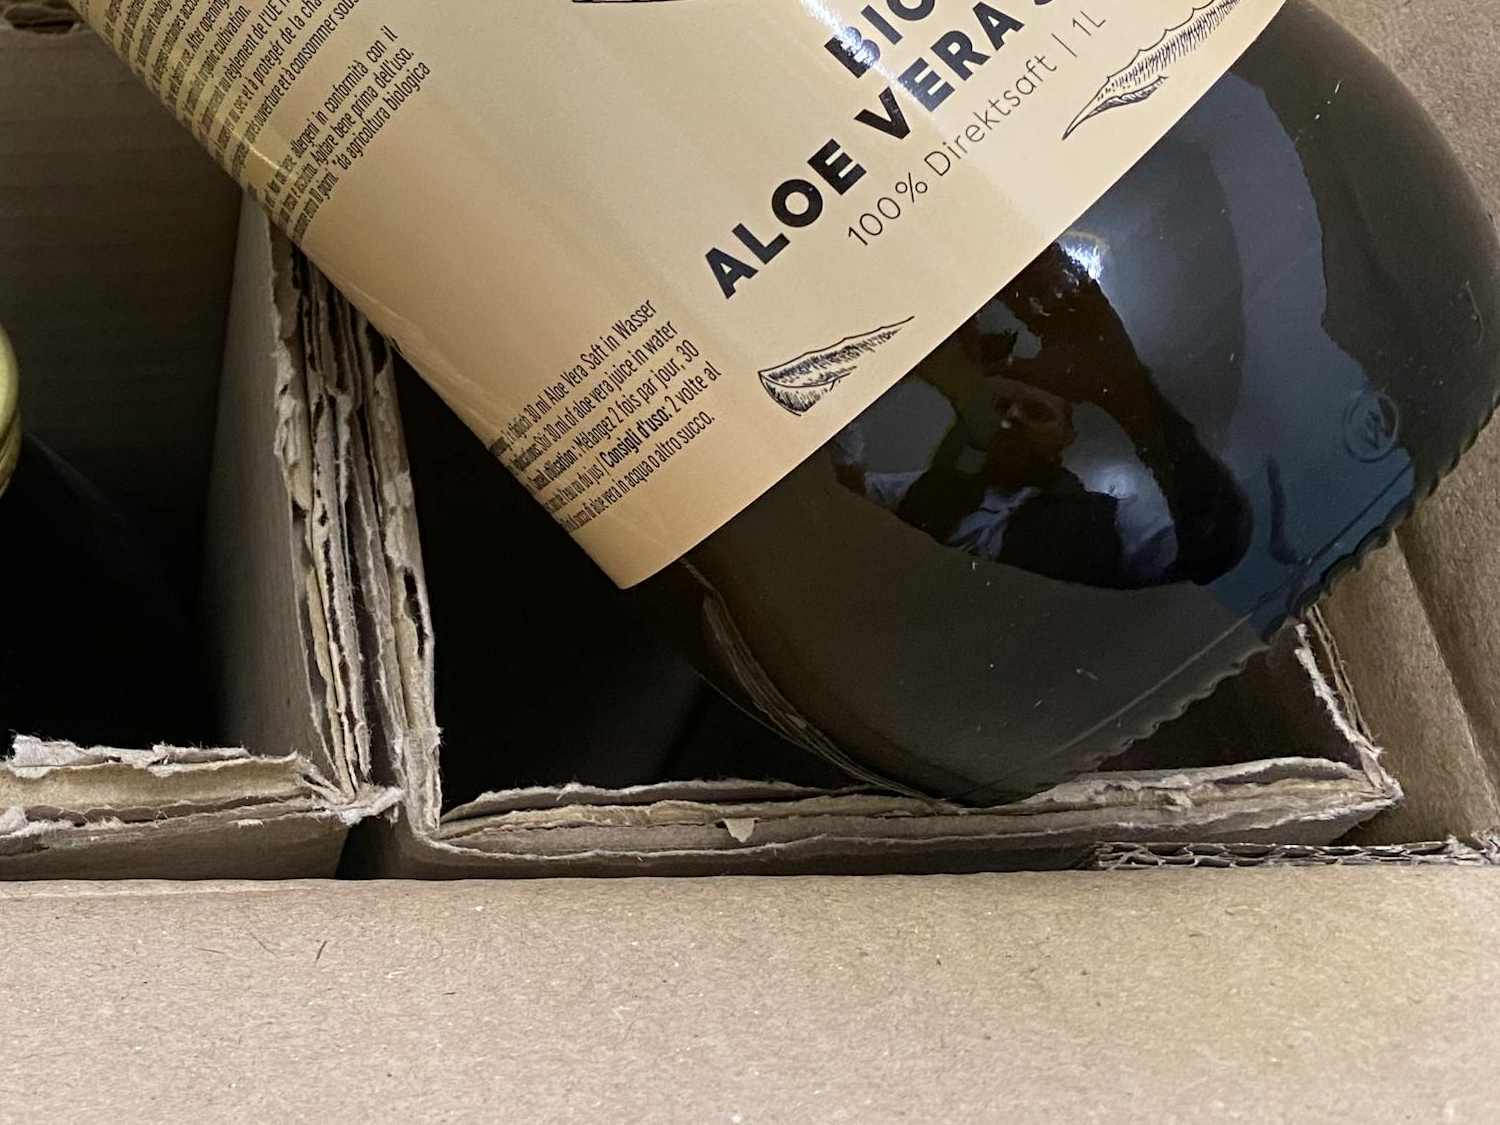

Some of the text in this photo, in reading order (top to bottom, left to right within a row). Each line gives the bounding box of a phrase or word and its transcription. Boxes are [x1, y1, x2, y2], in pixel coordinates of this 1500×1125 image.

[213, 5, 252, 55] cultivation.
[287, 14, 306, 31] la
[184, 26, 206, 54] After
[278, 26, 297, 45] de
[289, 13, 339, 75] consommer
[222, 33, 260, 83] règlement
[250, 22, 268, 41] de
[252, 39, 286, 87] protegér
[244, 76, 259, 91] à
[277, 73, 292, 91] et
[280, 66, 297, 82] à
[241, 83, 255, 101] et
[290, 117, 321, 159] allergeni
[311, 110, 329, 126] in
[323, 59, 370, 114] conformità
[365, 39, 388, 64] con
[380, 25, 398, 43] il
[253, 84, 285, 127] ouverture
[309, 133, 339, 170] Agitare
[329, 112, 357, 139] bene
[350, 85, 379, 121] prima
[372, 47, 415, 89] dell'uso.
[345, 106, 391, 160] agricoltura
[381, 62, 431, 111] biologica
[847, 172, 929, 246] 100%
[924, 53, 1058, 177] Direktsaft
[1072, 9, 1107, 36] 1L
[705, 138, 867, 299] ALOE
[854, 1, 1025, 141] VERA
[611, 300, 657, 340] Wasser
[598, 335, 621, 352] in
[641, 321, 678, 355] water
[580, 343, 610, 370] Saft
[627, 348, 650, 367] in
[675, 339, 700, 363] 30
[559, 364, 589, 388] Vera
[603, 358, 638, 392] juice
[649, 357, 686, 390] jour,
[703, 360, 722, 382] al
[543, 381, 570, 406] Aloe
[588, 379, 615, 403] vera
[635, 379, 659, 405] par
[674, 375, 709, 405] volte
[523, 403, 542, 424] 30
[534, 394, 553, 416] ml
[572, 396, 597, 419] aloe
[607, 406, 625, 424] 2
[614, 393, 642, 418] fois
[663, 395, 682, 413] 2
[554, 414, 572, 436] ml
[563, 406, 580, 427] of
[635, 405, 674, 439] d'uso:
[676, 411, 716, 444] succo.
[532, 432, 554, 452] Stir
[542, 423, 562, 443] 30
[572, 415, 618, 455] Mélangez
[598, 427, 644, 468] Consigli
[654, 436, 683, 463] altro
[647, 454, 661, 469] o
[576, 471, 595, 489] du
[582, 463, 605, 486] jus
[623, 460, 654, 488] acqua
[600, 485, 623, 506] vera
[611, 478, 631, 495] in
